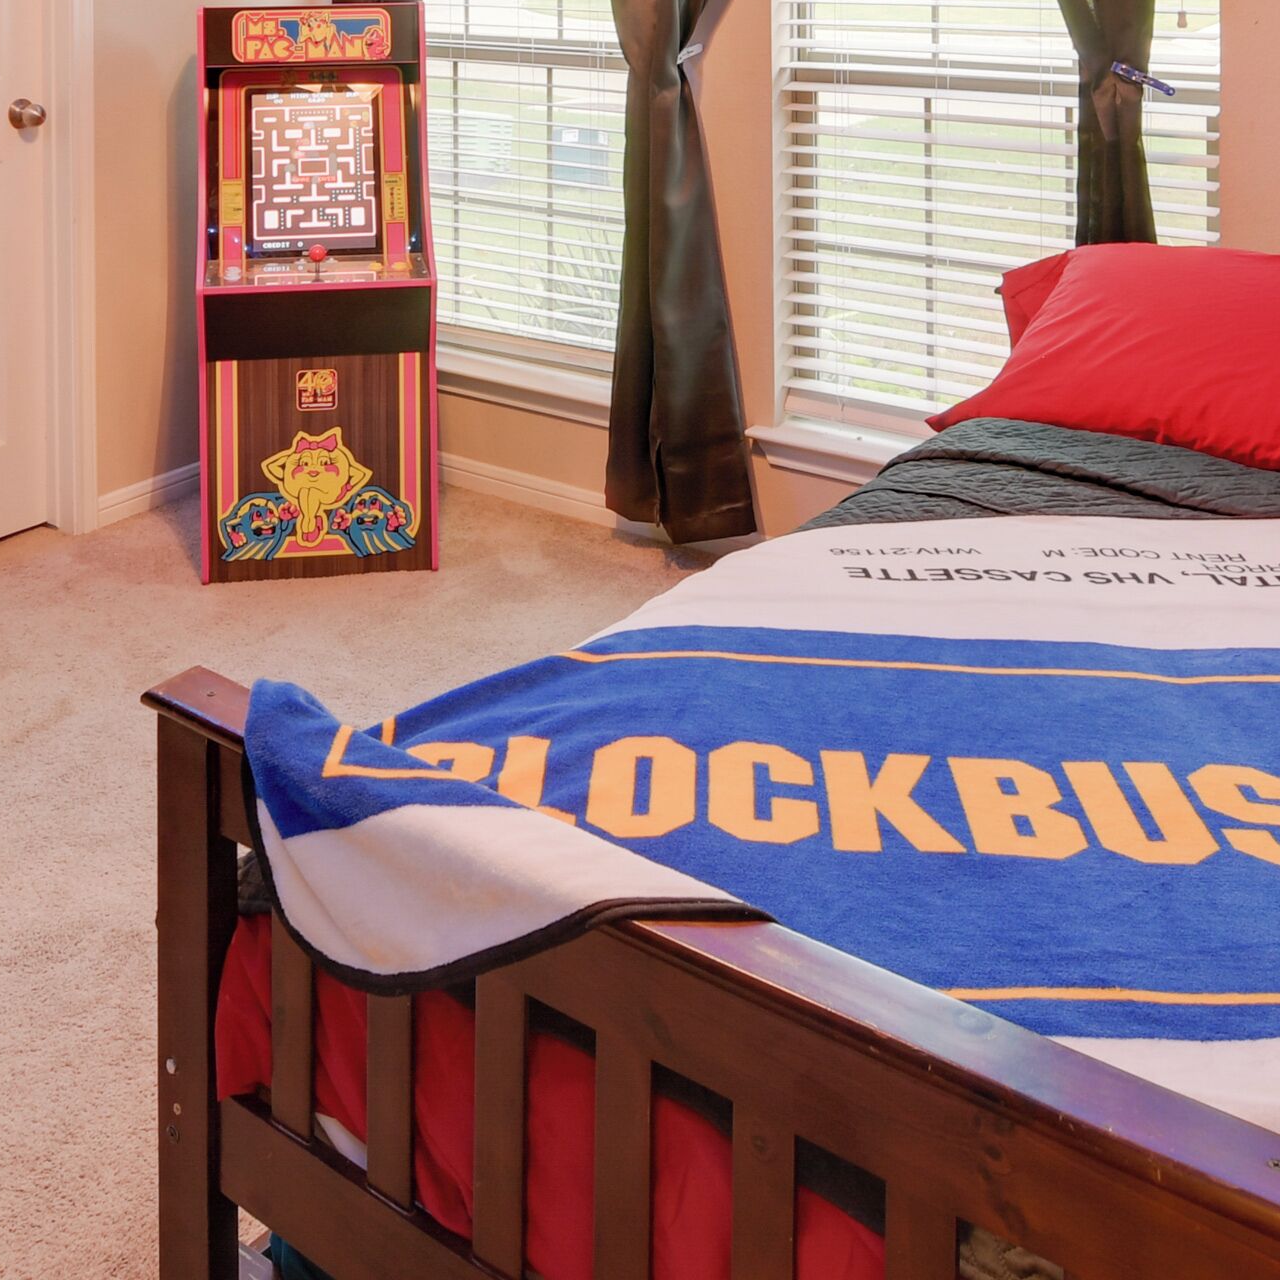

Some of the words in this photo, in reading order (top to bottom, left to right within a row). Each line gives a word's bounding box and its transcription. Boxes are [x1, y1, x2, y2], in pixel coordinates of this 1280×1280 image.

[246, 32, 364, 60] PAC-MAN
[262, 241, 291, 249] CREDIT
[1042, 548, 1067, 559] M
[1070, 546, 1162, 561] CODE:
[1169, 550, 1247, 563] RENT
[841, 565, 1073, 585] CASSETTE
[1086, 570, 1176, 586] VHS
